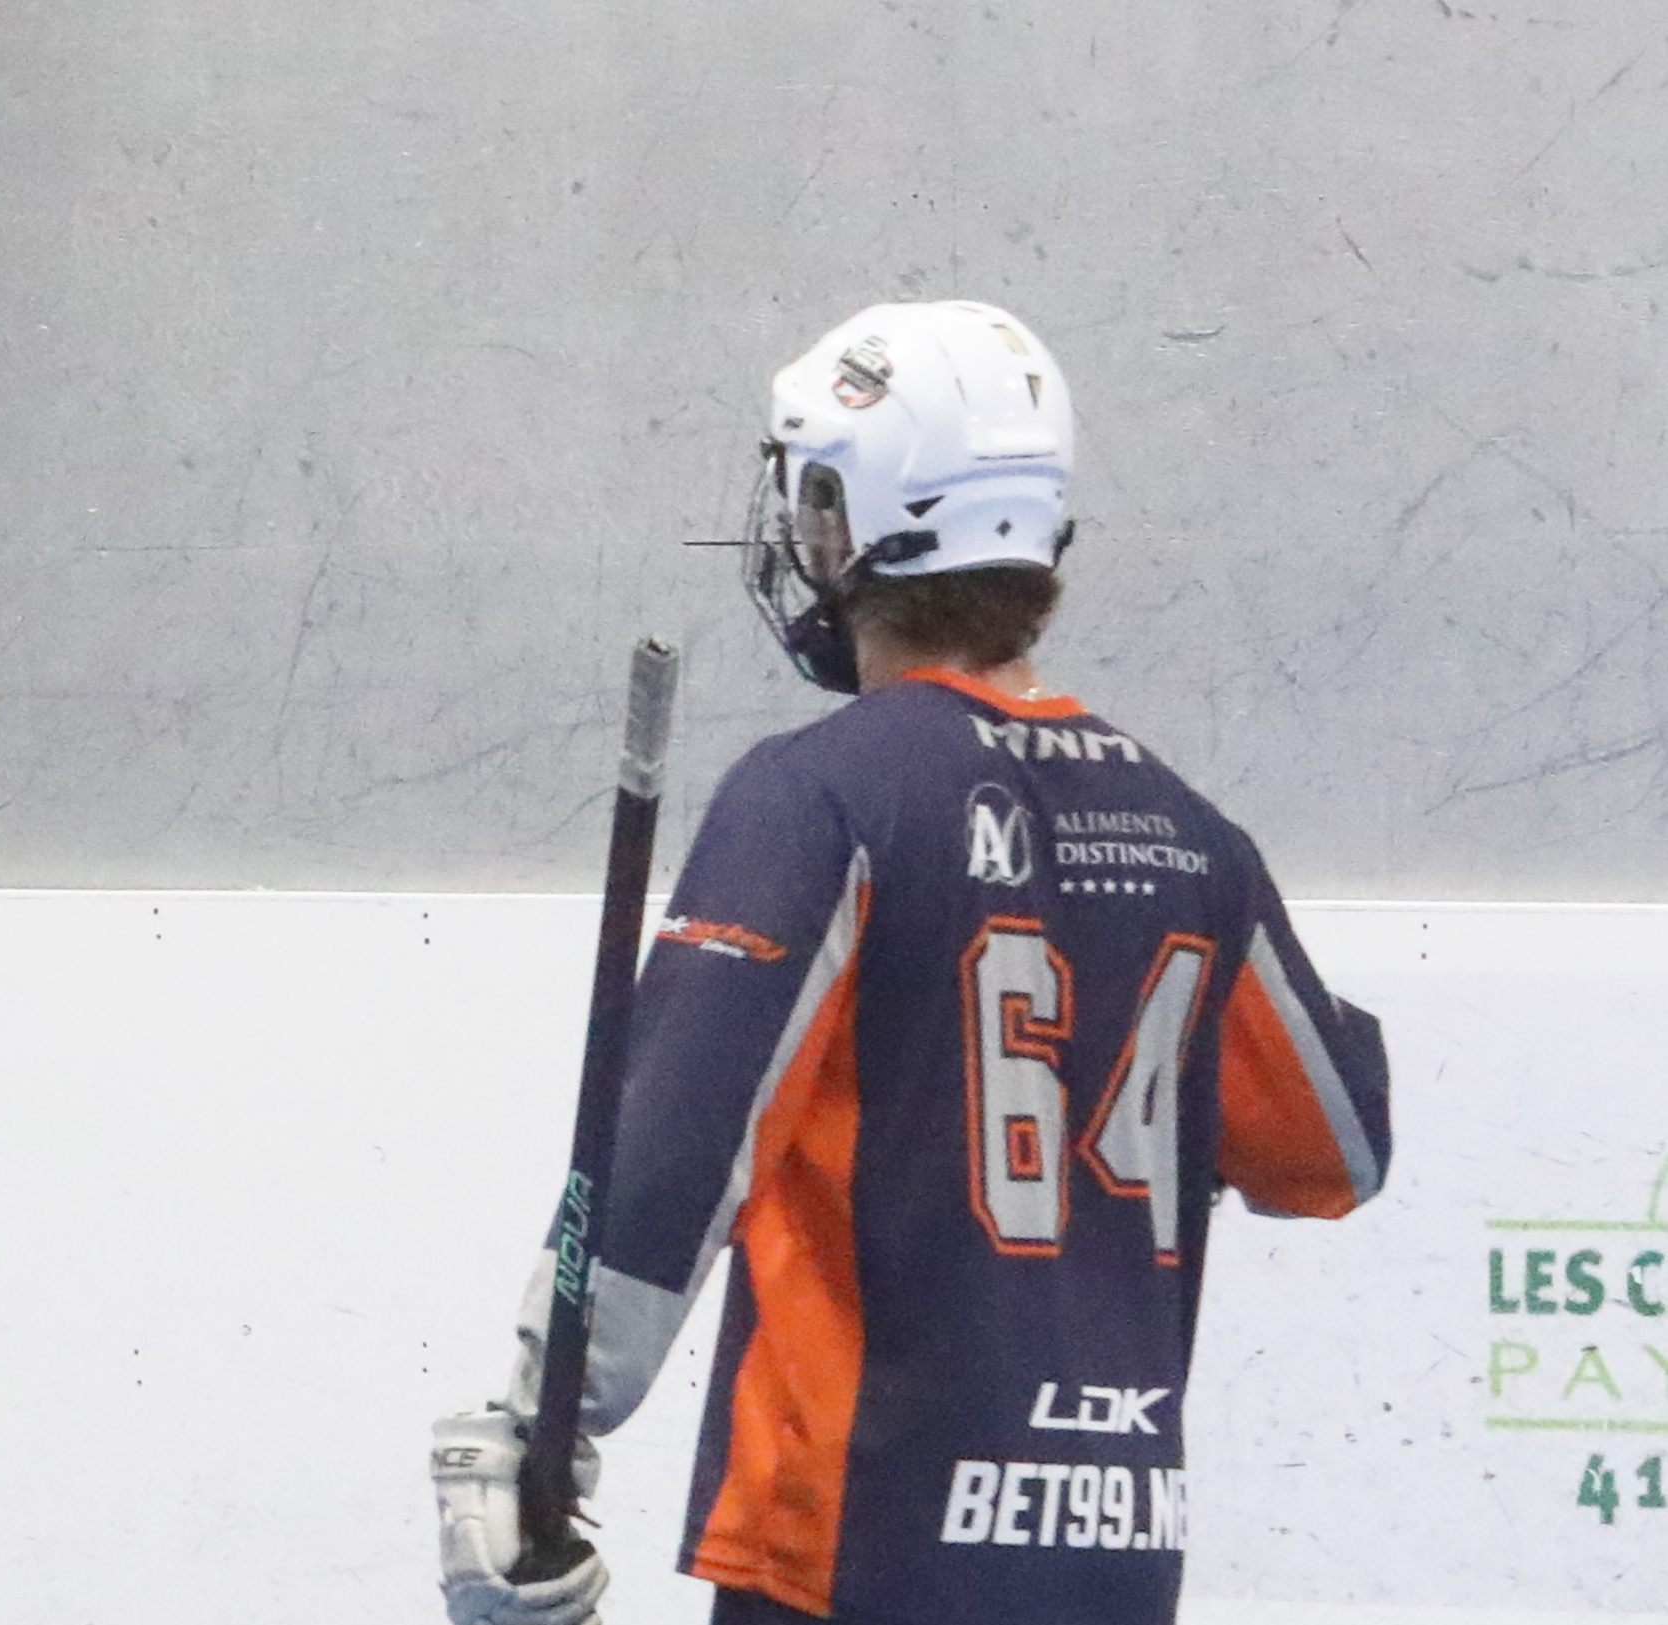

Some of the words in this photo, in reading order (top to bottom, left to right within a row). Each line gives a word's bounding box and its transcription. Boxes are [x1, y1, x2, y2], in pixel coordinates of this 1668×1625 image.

[967, 714, 1141, 763] MNM
[1053, 811, 1177, 839] ALIMENTS
[960, 914, 1216, 1267] 64
[1489, 1247, 1606, 1316] LES
[1627, 1249, 1668, 1318] C
[1029, 1382, 1172, 1435] LDK
